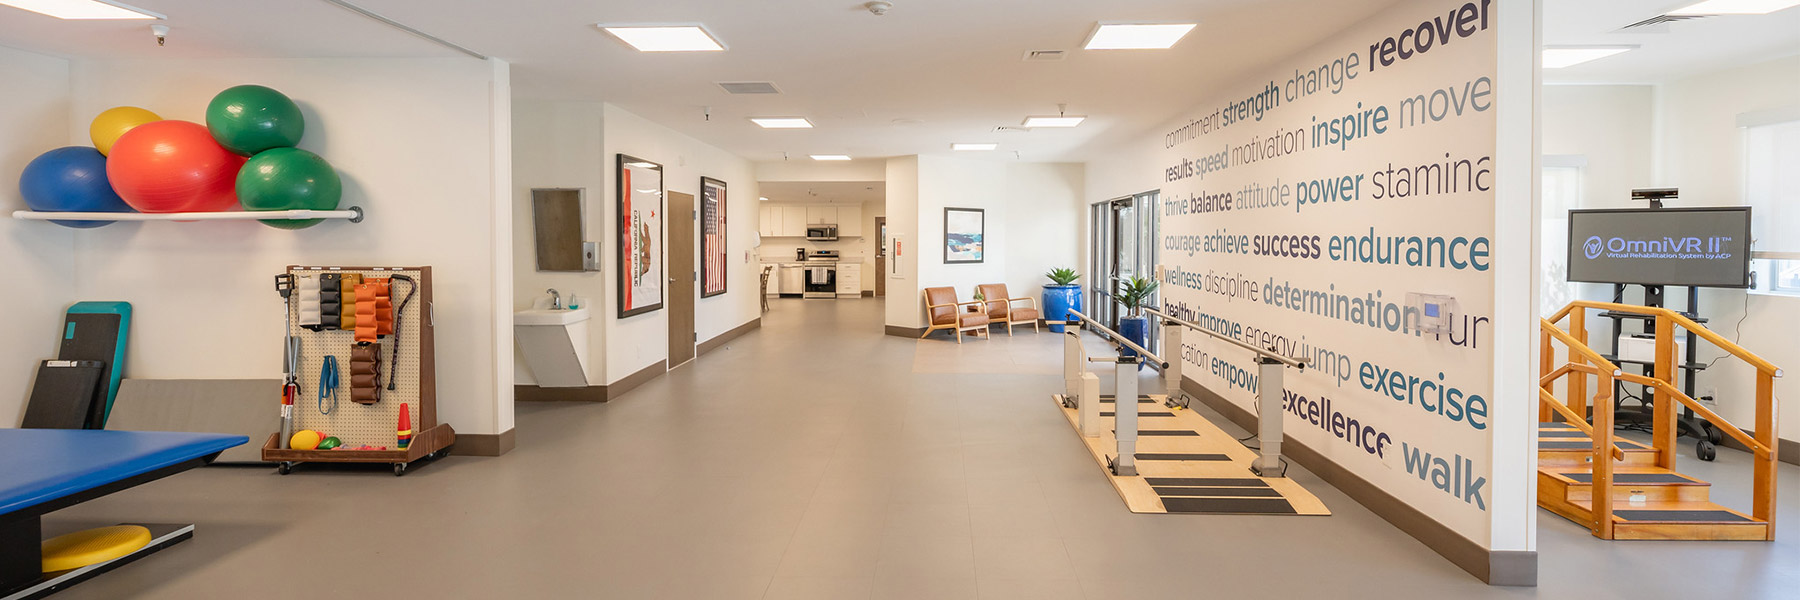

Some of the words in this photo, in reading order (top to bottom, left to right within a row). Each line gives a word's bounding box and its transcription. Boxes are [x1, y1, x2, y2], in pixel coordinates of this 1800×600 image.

[1165, 109, 1220, 150] commitment
[1222, 80, 1280, 127] strength
[1285, 52, 1360, 103] change
[1165, 158, 1194, 183] results
[1195, 144, 1229, 180] speed
[1232, 126, 1306, 168] motivation
[1312, 101, 1390, 151] inspire
[1400, 75, 1491, 129] move
[1165, 196, 1188, 217] thrive
[1190, 190, 1233, 215] balance
[1235, 177, 1291, 211] attitude
[1296, 173, 1365, 213] power
[1165, 231, 1201, 257] courage
[1203, 228, 1250, 255] achieve
[1253, 235, 1321, 260] success
[1328, 227, 1490, 272] endurance
[1607, 237, 1702, 252] OmniVR
[1164, 266, 1203, 291] wellness
[1204, 271, 1259, 303] discipline
[1263, 277, 1421, 337] determination
[1164, 297, 1196, 332] healthy
[1197, 305, 1242, 339] improve
[1299, 334, 1352, 388] jump
[1359, 361, 1488, 430] exercise
[1401, 442, 1487, 512] walk
